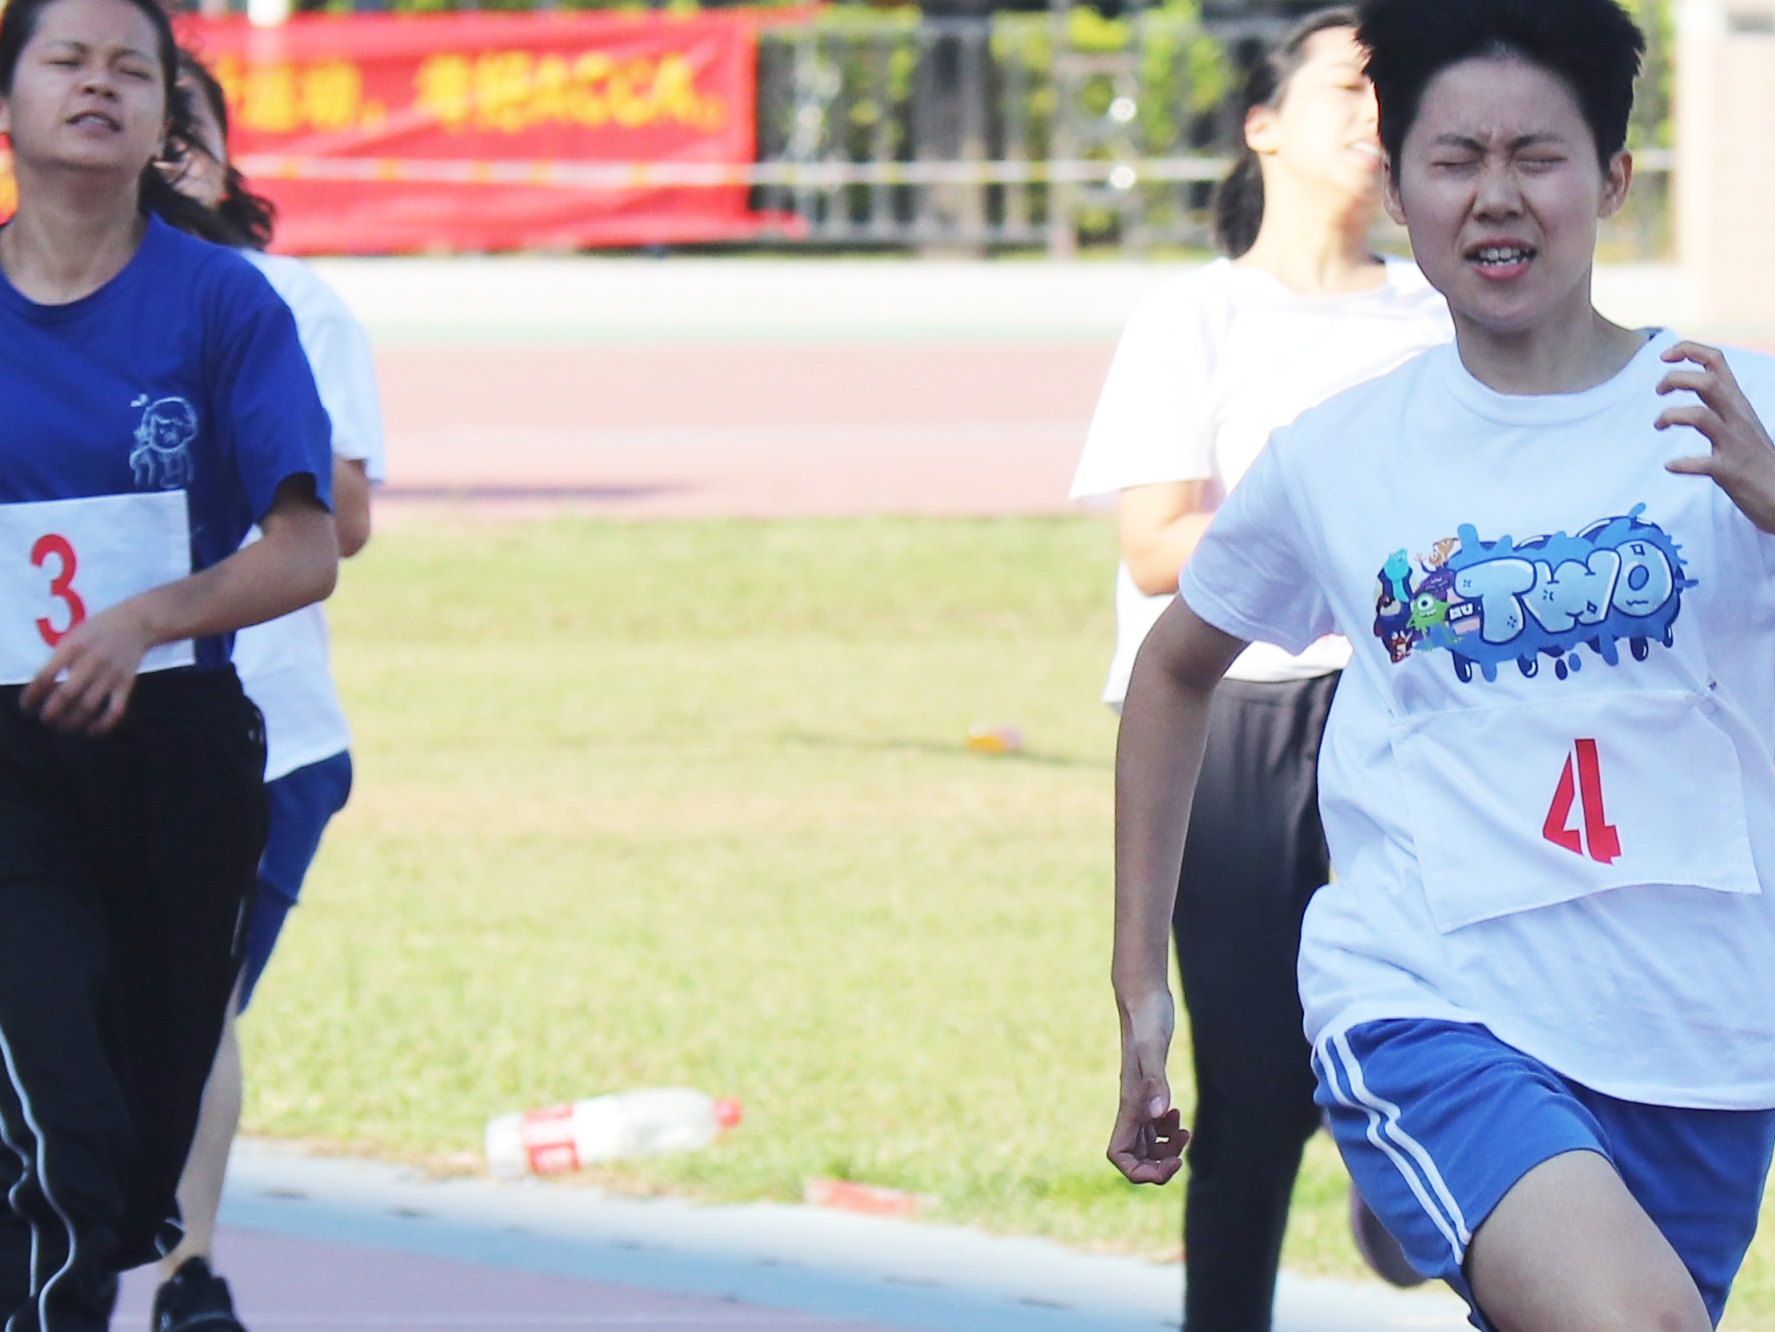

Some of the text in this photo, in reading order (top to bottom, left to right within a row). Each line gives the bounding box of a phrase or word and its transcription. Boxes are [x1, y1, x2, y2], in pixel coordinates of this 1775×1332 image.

[30, 532, 87, 648] 3
[1455, 539, 1674, 644] TWO
[1542, 738, 1622, 865] 4
